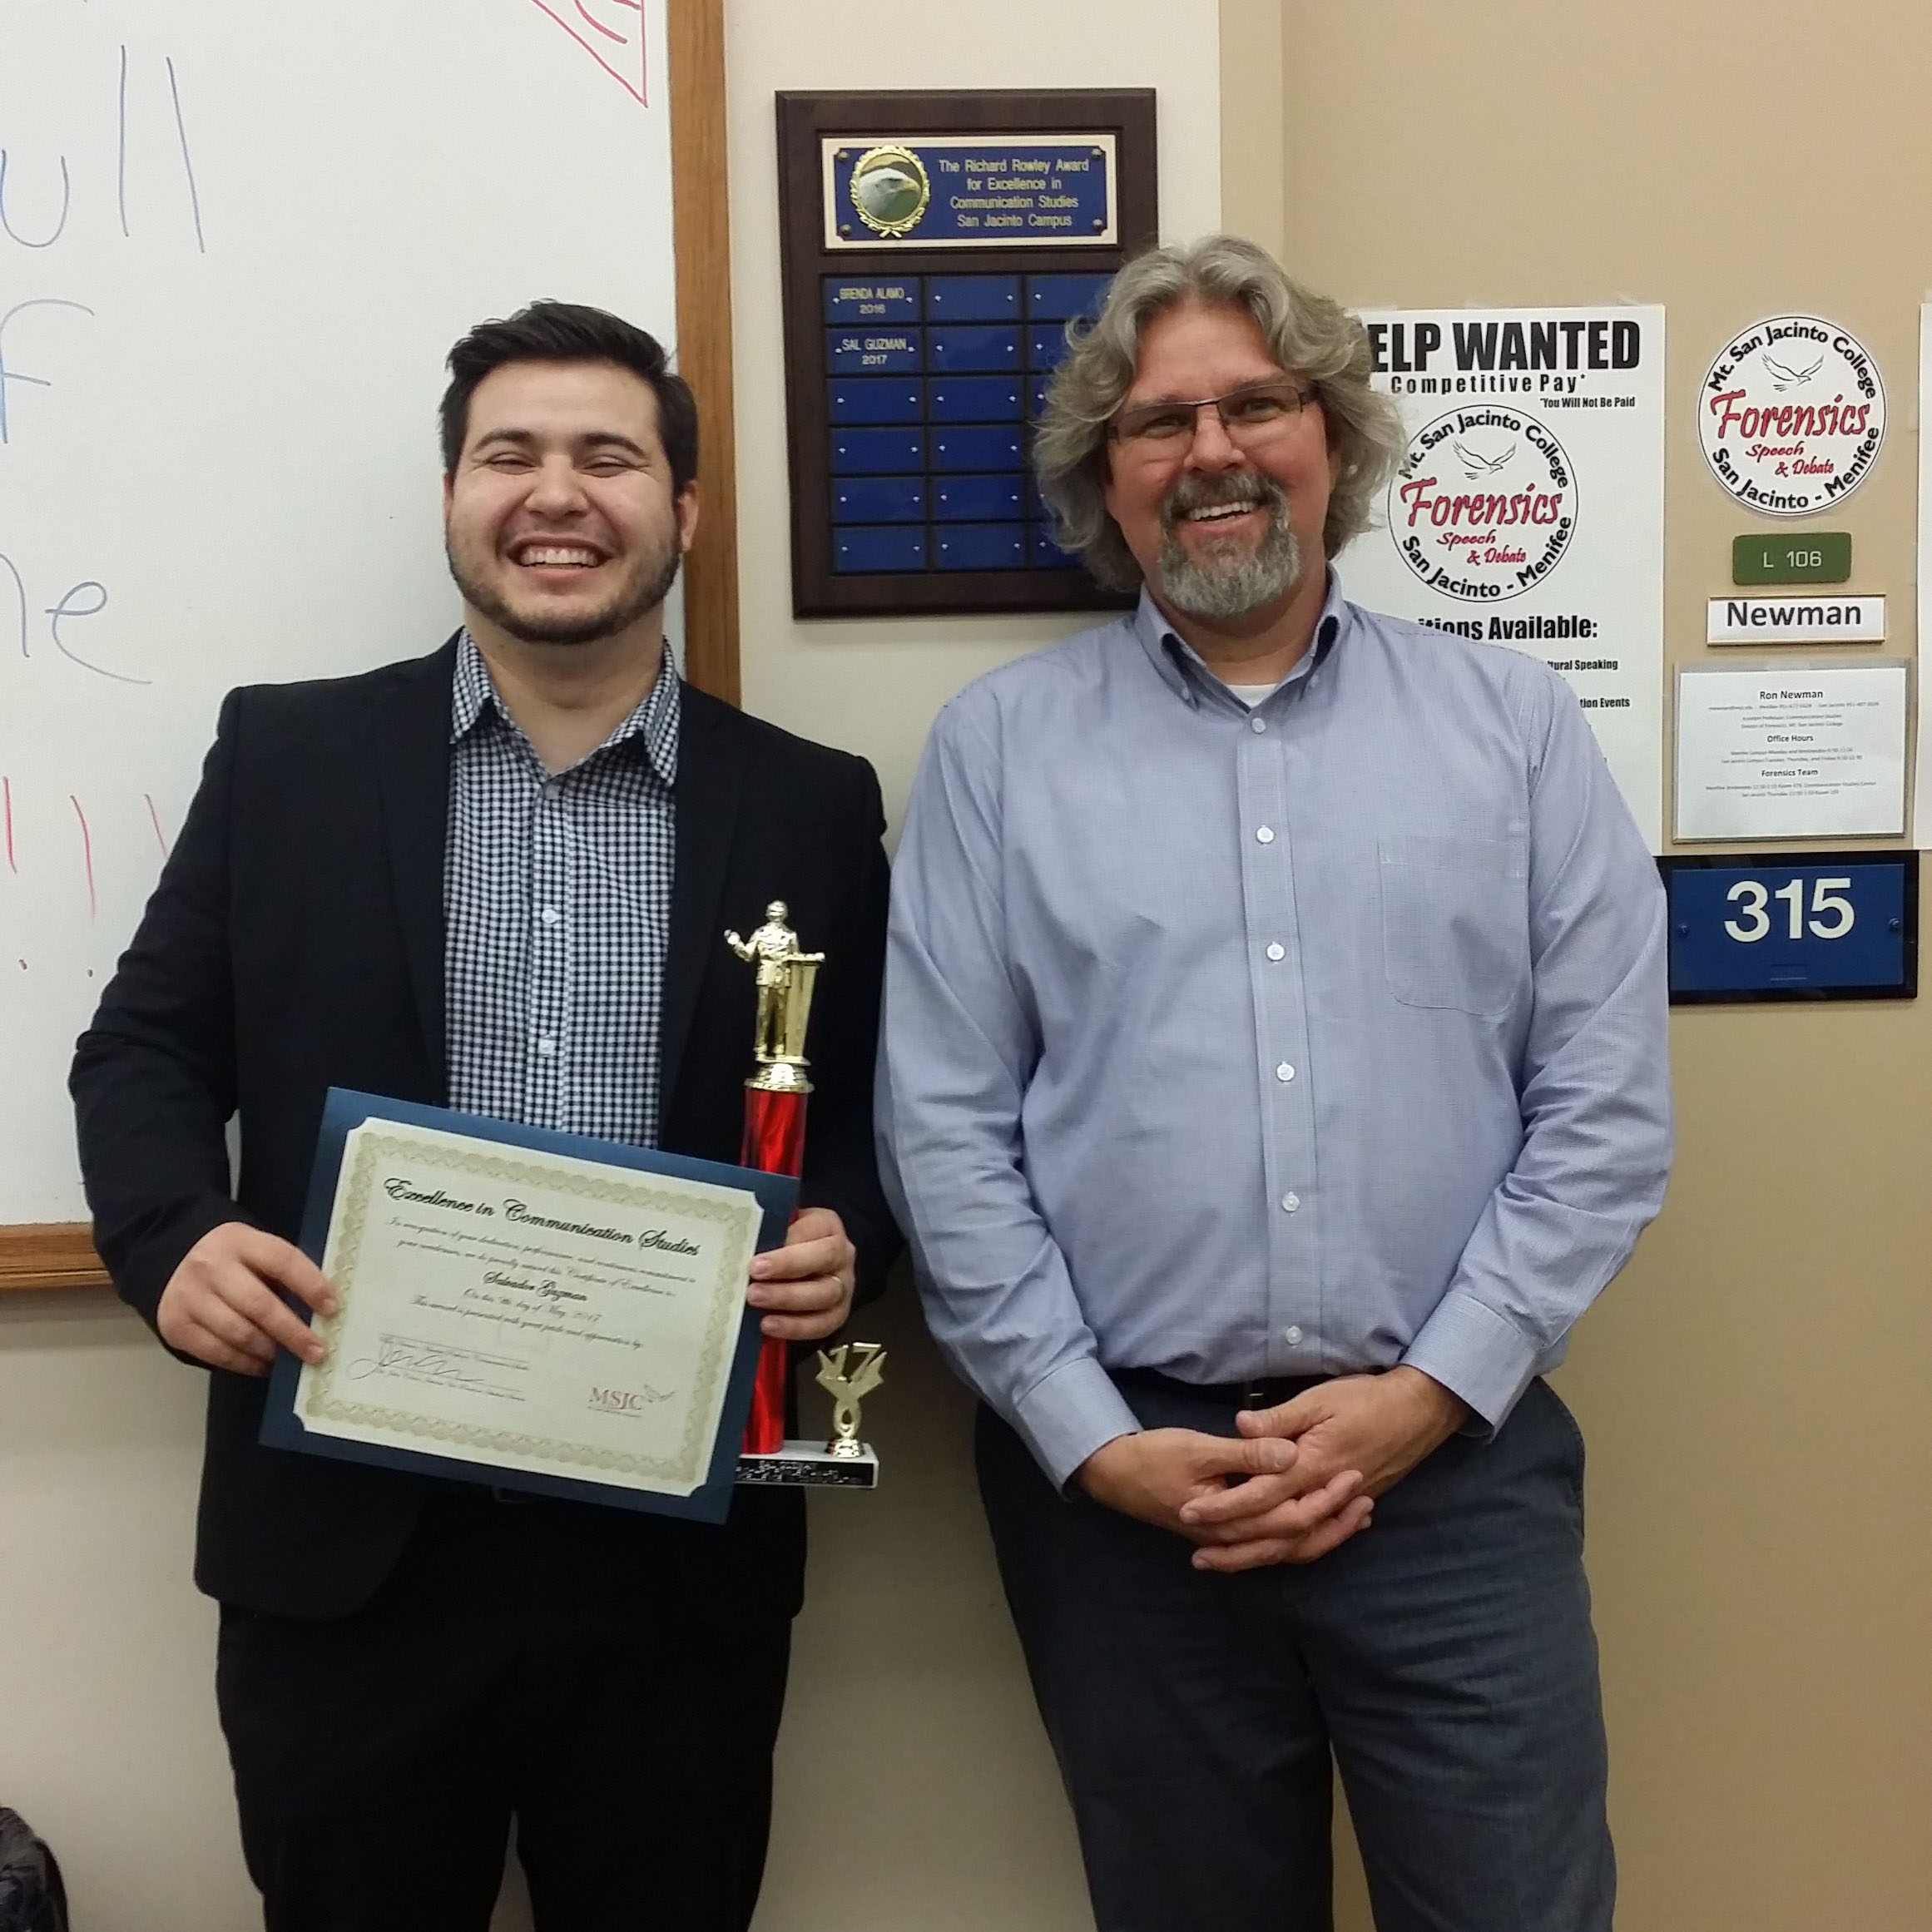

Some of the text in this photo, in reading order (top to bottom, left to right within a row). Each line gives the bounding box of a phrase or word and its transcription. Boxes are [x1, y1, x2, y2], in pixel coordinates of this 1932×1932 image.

[939, 158, 1089, 175] The Richard Rowley Award
[967, 176, 1062, 191] for Excellence in
[950, 195, 1079, 210] Communication Studies
[958, 213, 1072, 229] San Jacinto Campus
[842, 338, 907, 351] SAL GUZMAN
[1367, 320, 1640, 373] ELP WANTED
[862, 354, 889, 365] 2017
[1708, 322, 1876, 399] Mt. San Jacinto College
[1390, 375, 1532, 395] Competitive
[1561, 397, 1582, 408] Will
[1583, 397, 1598, 408] Not
[1599, 397, 1612, 408] Be
[1614, 396, 1636, 408] Paid
[1711, 389, 1870, 439] Forensics
[1420, 424, 1454, 450] San
[1458, 409, 1521, 433] Jacinto
[1525, 425, 1568, 488] College
[1746, 440, 1805, 463] Speech
[1713, 448, 1740, 485] San
[1736, 479, 1808, 508] Jacinto
[1824, 427, 1879, 498] Menifee
[1775, 456, 1834, 478] & Debate
[1400, 477, 1563, 527] Forensics
[1436, 529, 1497, 551] Speech
[1403, 536, 1430, 573] San
[1427, 567, 1500, 597] Jacinto
[1516, 517, 1572, 587] Menifee
[1467, 545, 1526, 566] & Debate
[1763, 551, 1822, 567] L 106
[1727, 602, 1861, 627] Newman
[1489, 615, 1598, 640] Available:
[1575, 659, 1618, 671] Speaking
[1580, 698, 1630, 708] tion Events
[1760, 690, 1823, 700] Ron Newman
[1761, 768, 1818, 777] Forensics Team
[1724, 877, 1855, 943] 315
[384, 1177, 473, 1212] Excellence
[475, 1203, 495, 1216] in
[503, 1198, 634, 1243] Communication
[638, 1229, 701, 1256] Studies
